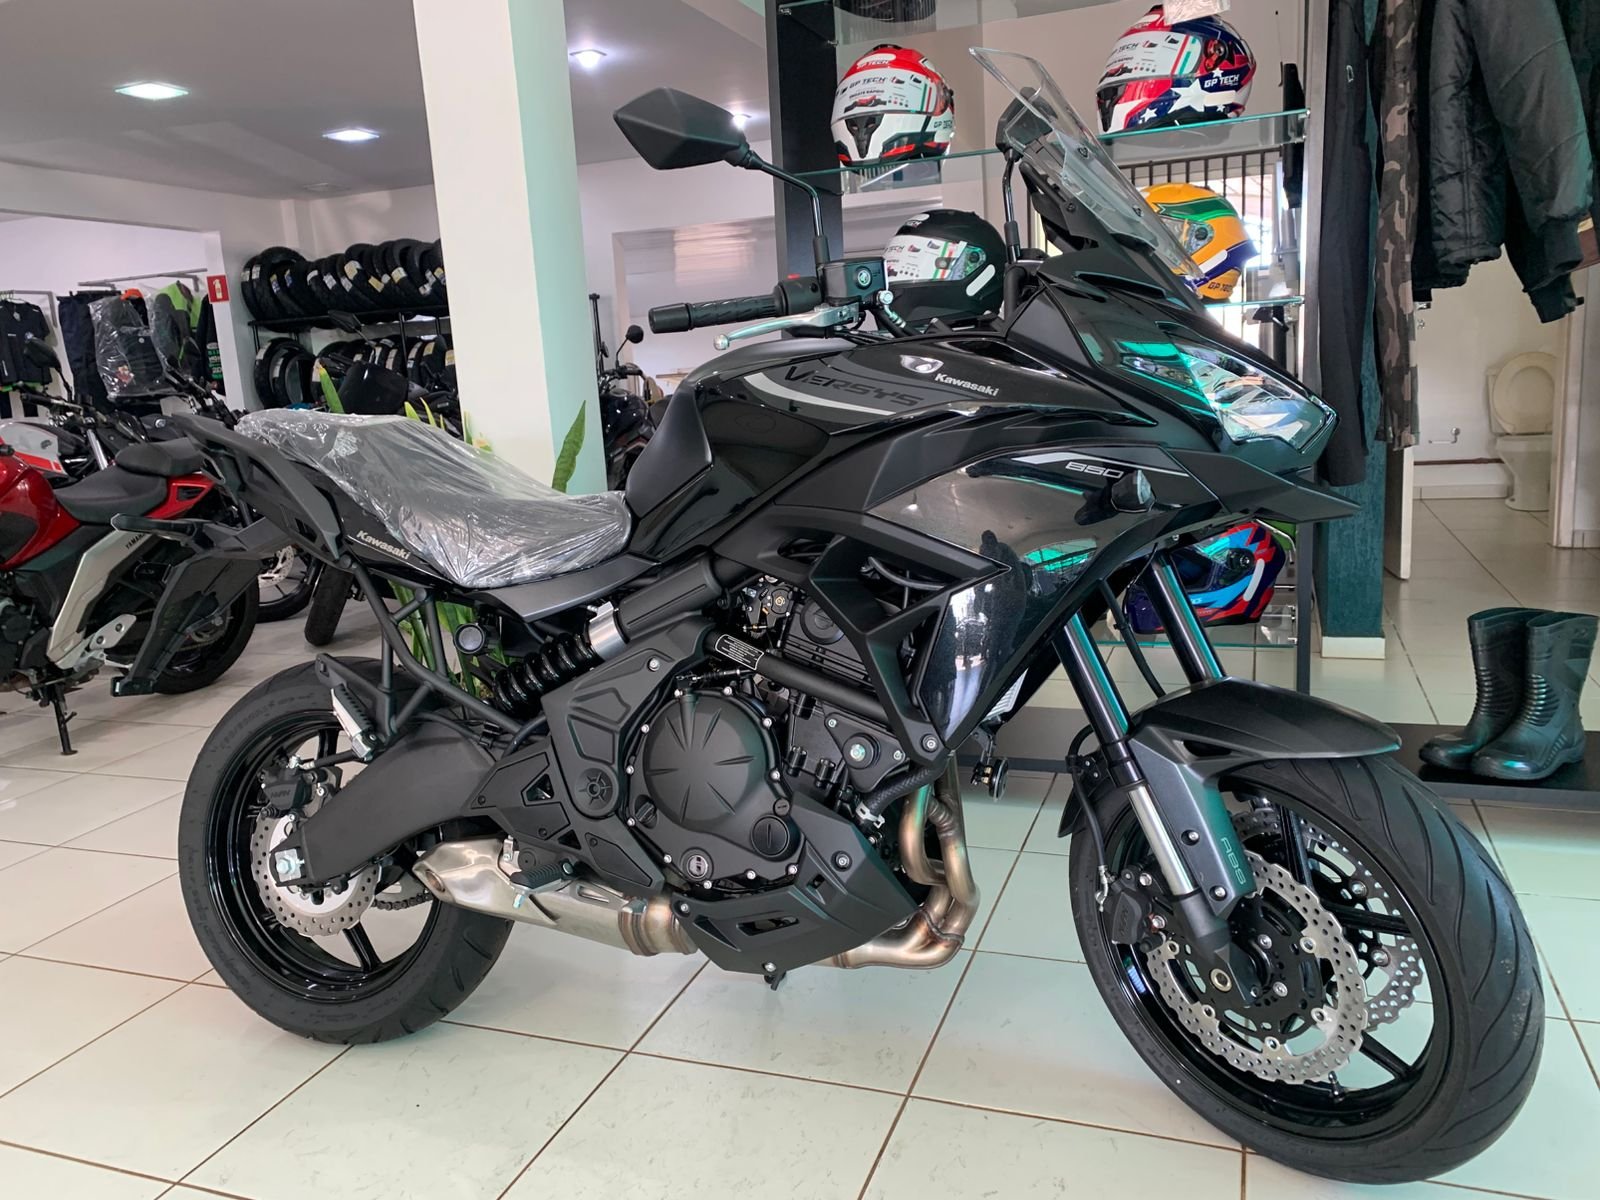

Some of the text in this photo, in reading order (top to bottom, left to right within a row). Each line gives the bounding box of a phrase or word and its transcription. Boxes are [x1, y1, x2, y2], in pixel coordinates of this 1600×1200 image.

[862, 77, 886, 85] TECH
[1203, 78, 1219, 88] GP
[1219, 73, 1240, 84] TECH
[785, 366, 924, 406] VERSYS
[934, 372, 1000, 397] Kawasaki
[1065, 461, 1124, 479] 650
[356, 530, 412, 560] Kawasaki
[1221, 837, 1246, 885] ABS
